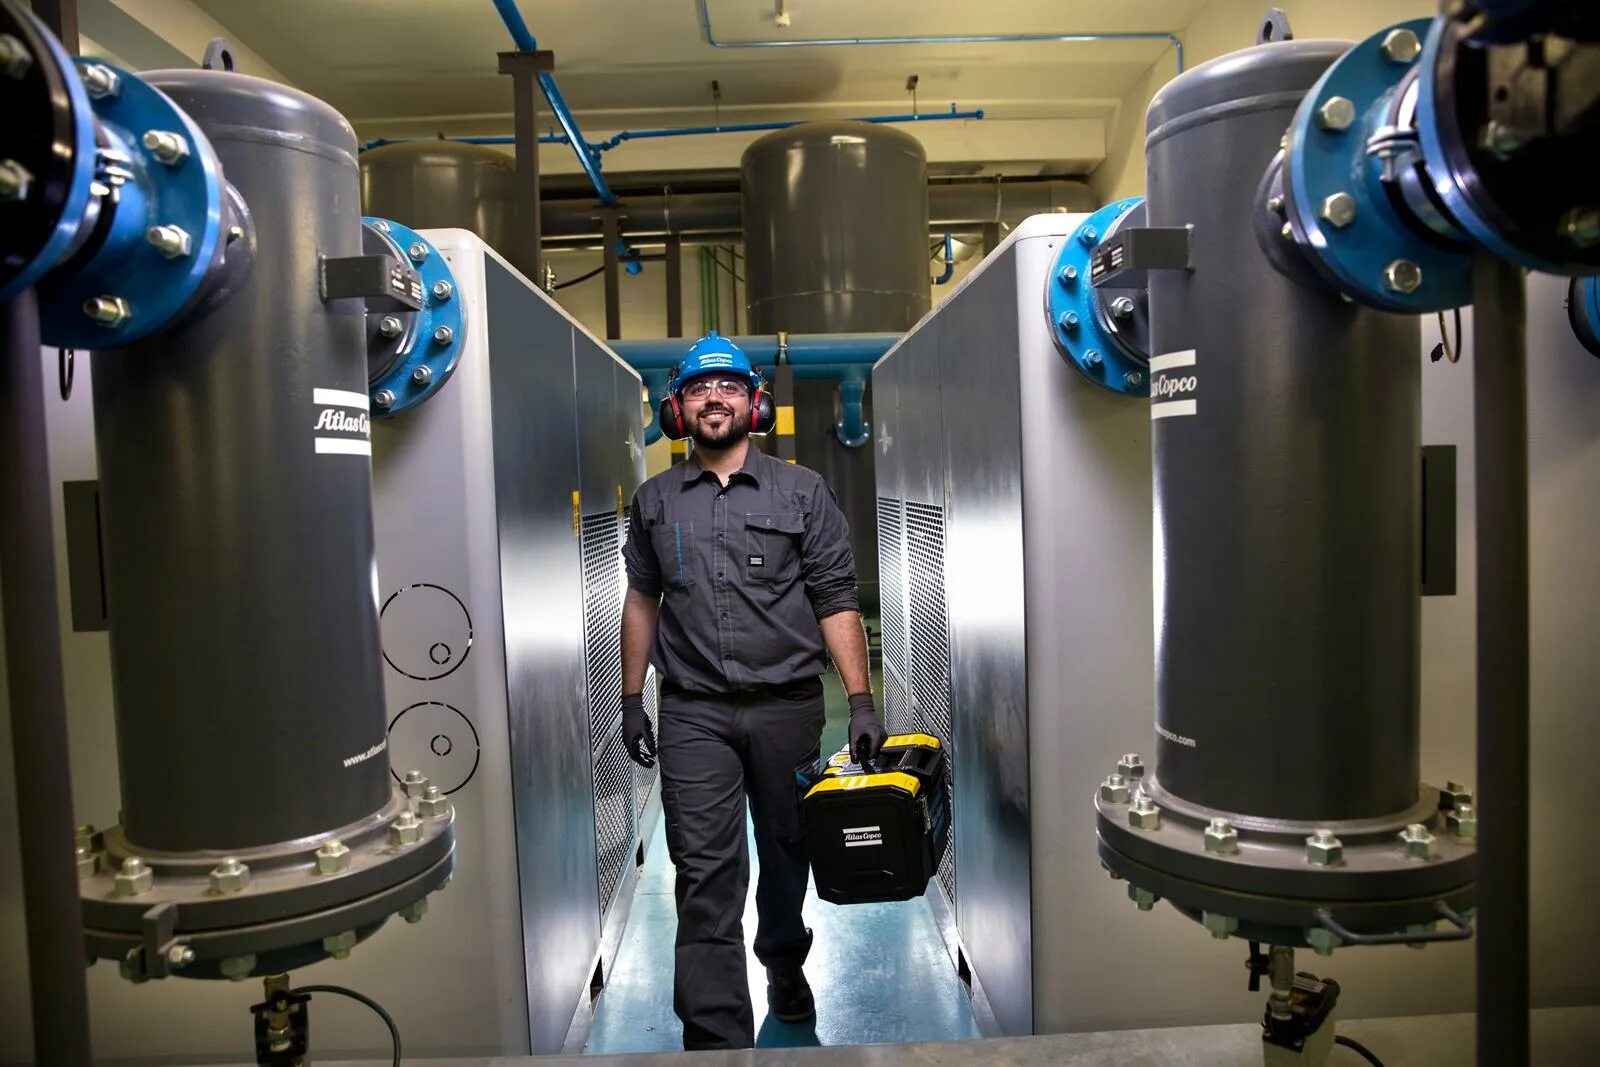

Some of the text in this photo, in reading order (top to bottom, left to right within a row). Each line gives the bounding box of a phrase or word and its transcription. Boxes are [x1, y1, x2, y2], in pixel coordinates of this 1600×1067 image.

[1158, 374, 1197, 398] Copco
[313, 409, 359, 432] Atlas
[845, 832, 882, 841] Atlas Copco
